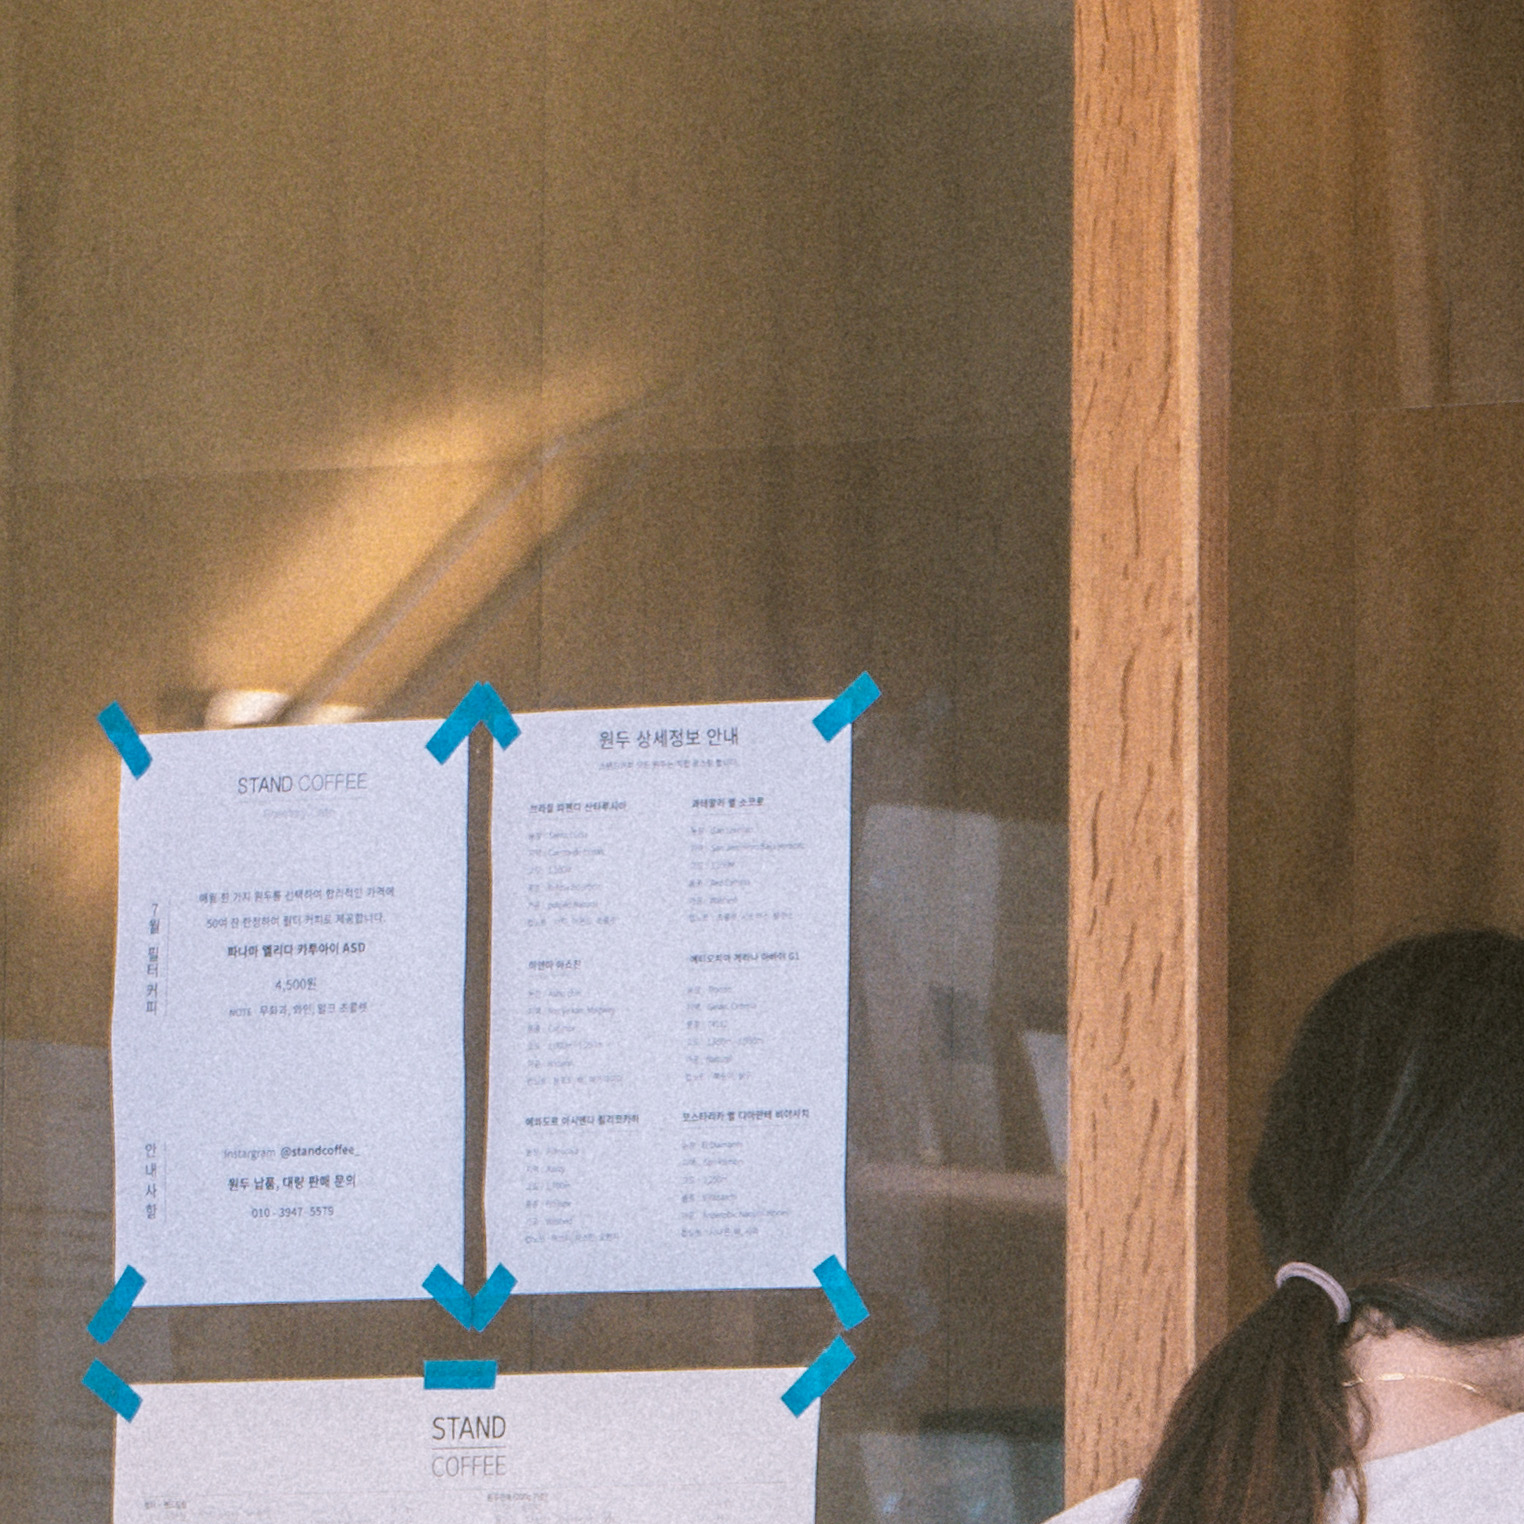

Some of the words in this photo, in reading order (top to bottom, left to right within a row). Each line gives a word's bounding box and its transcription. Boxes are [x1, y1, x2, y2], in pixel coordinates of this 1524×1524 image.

[599, 730, 631, 750] 원두
[636, 729, 701, 749] 상세정보
[706, 726, 739, 747] 안내
[238, 775, 293, 794] STAND
[298, 773, 368, 792] COFFEE
[227, 944, 259, 958] 파나마
[342, 941, 366, 954] ASD
[275, 977, 317, 992] 4,500원
[280, 1144, 360, 1159] @standcoffee_
[228, 1177, 250, 1192] 원두
[282, 1175, 305, 1190] 대량
[308, 1174, 331, 1189] 판매
[334, 1173, 356, 1188] 문의
[251, 1207, 271, 1219] 010
[432, 1415, 507, 1441] STAND
[431, 1455, 507, 1478] COFFEE
